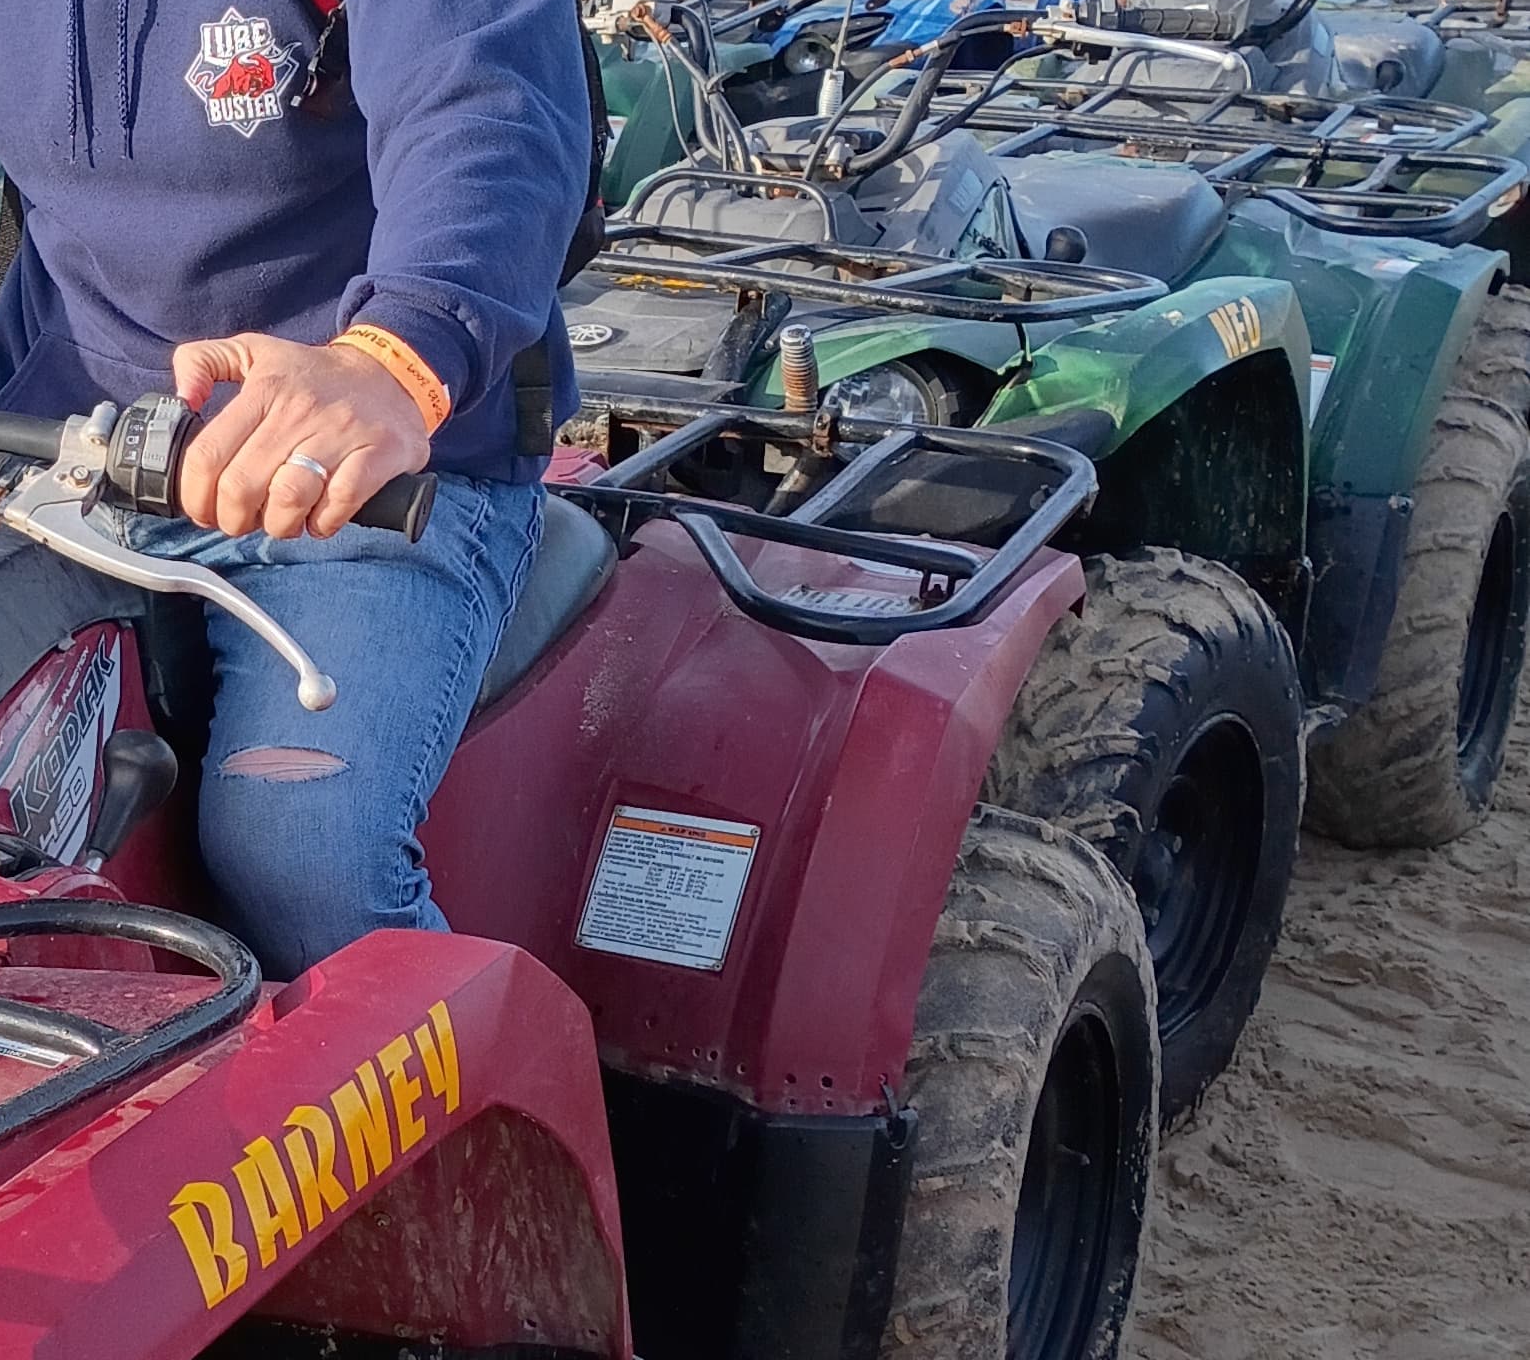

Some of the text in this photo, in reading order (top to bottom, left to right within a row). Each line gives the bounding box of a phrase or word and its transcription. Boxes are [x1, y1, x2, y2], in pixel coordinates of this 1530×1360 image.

[208, 95, 282, 124] BUSTER
[1207, 296, 1263, 359] NEO
[9, 632, 116, 838] KODIAK
[168, 999, 461, 1310] BARNEY
